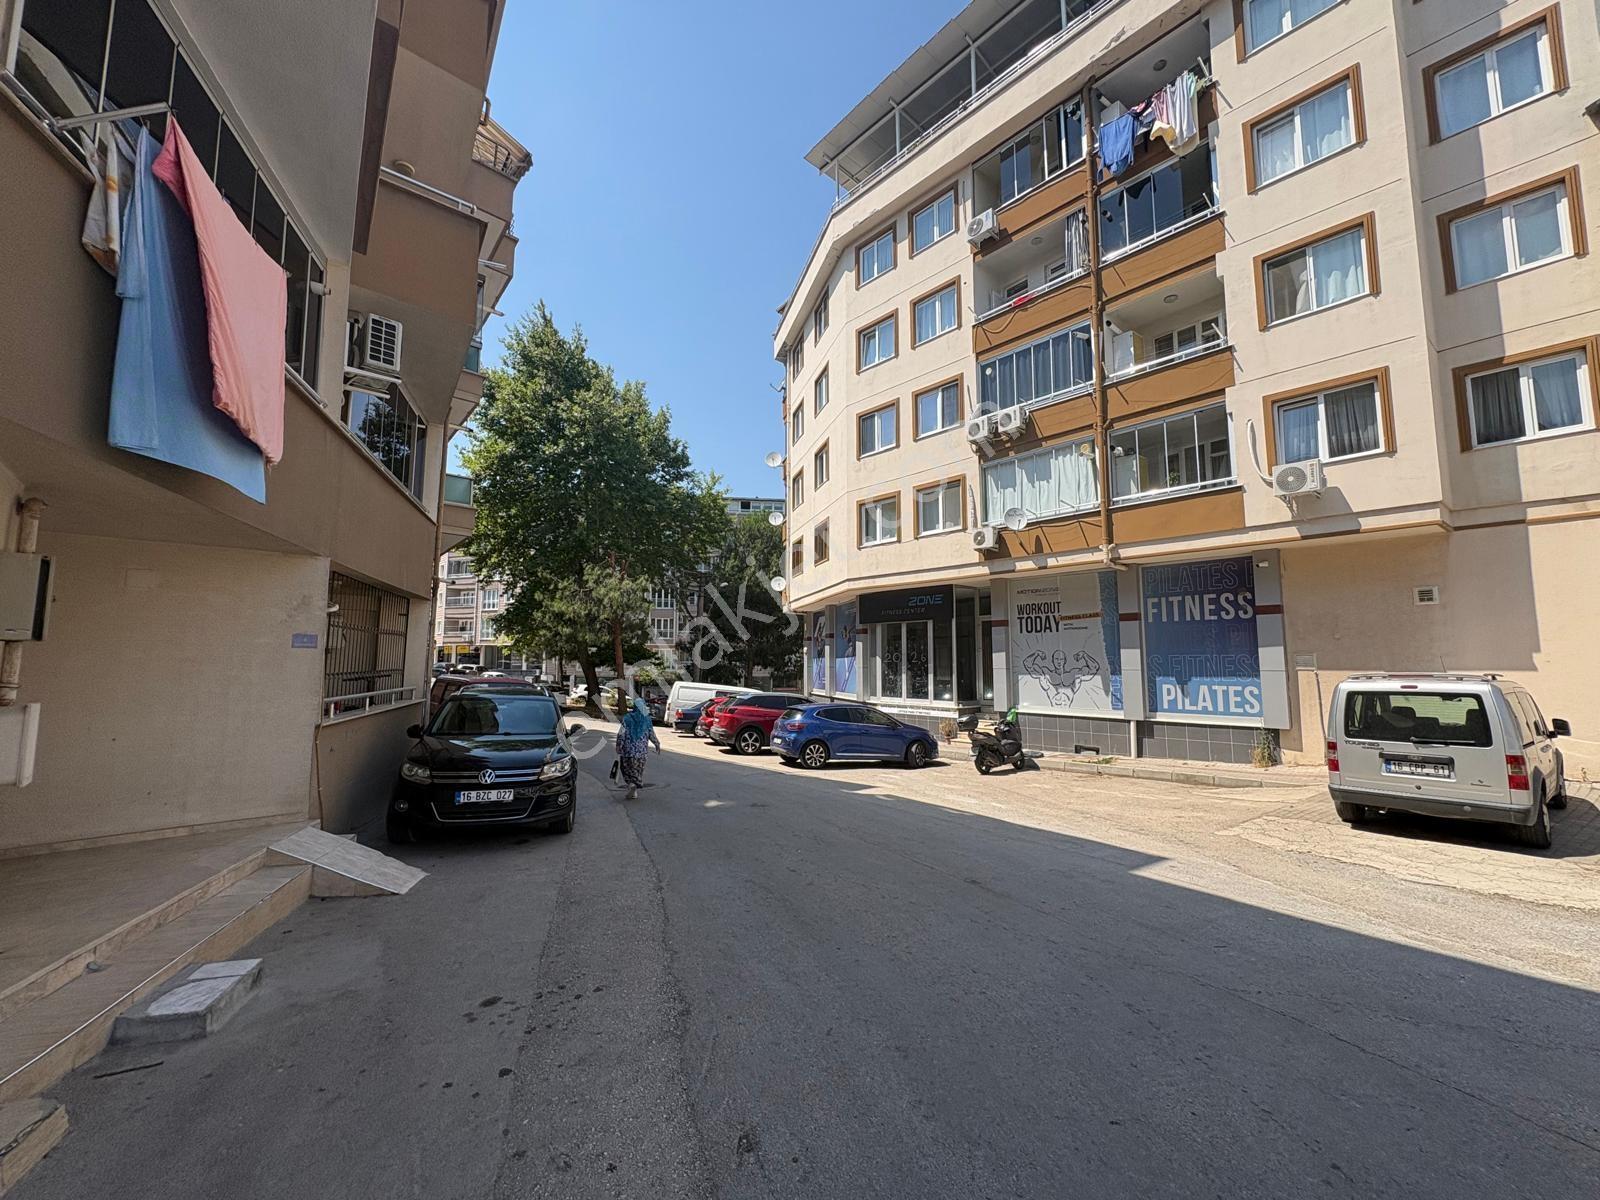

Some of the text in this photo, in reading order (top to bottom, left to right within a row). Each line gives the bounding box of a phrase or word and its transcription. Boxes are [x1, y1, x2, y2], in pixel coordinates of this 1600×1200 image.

[1145, 562, 1238, 593] PILATES
[908, 594, 944, 606] ZONE
[1016, 601, 1061, 616] WORKOUT
[1146, 592, 1254, 622] FITNESS
[1016, 615, 1061, 634] TODAY
[1161, 684, 1261, 714] PILATES
[462, 790, 513, 802] 16 BZC 027
